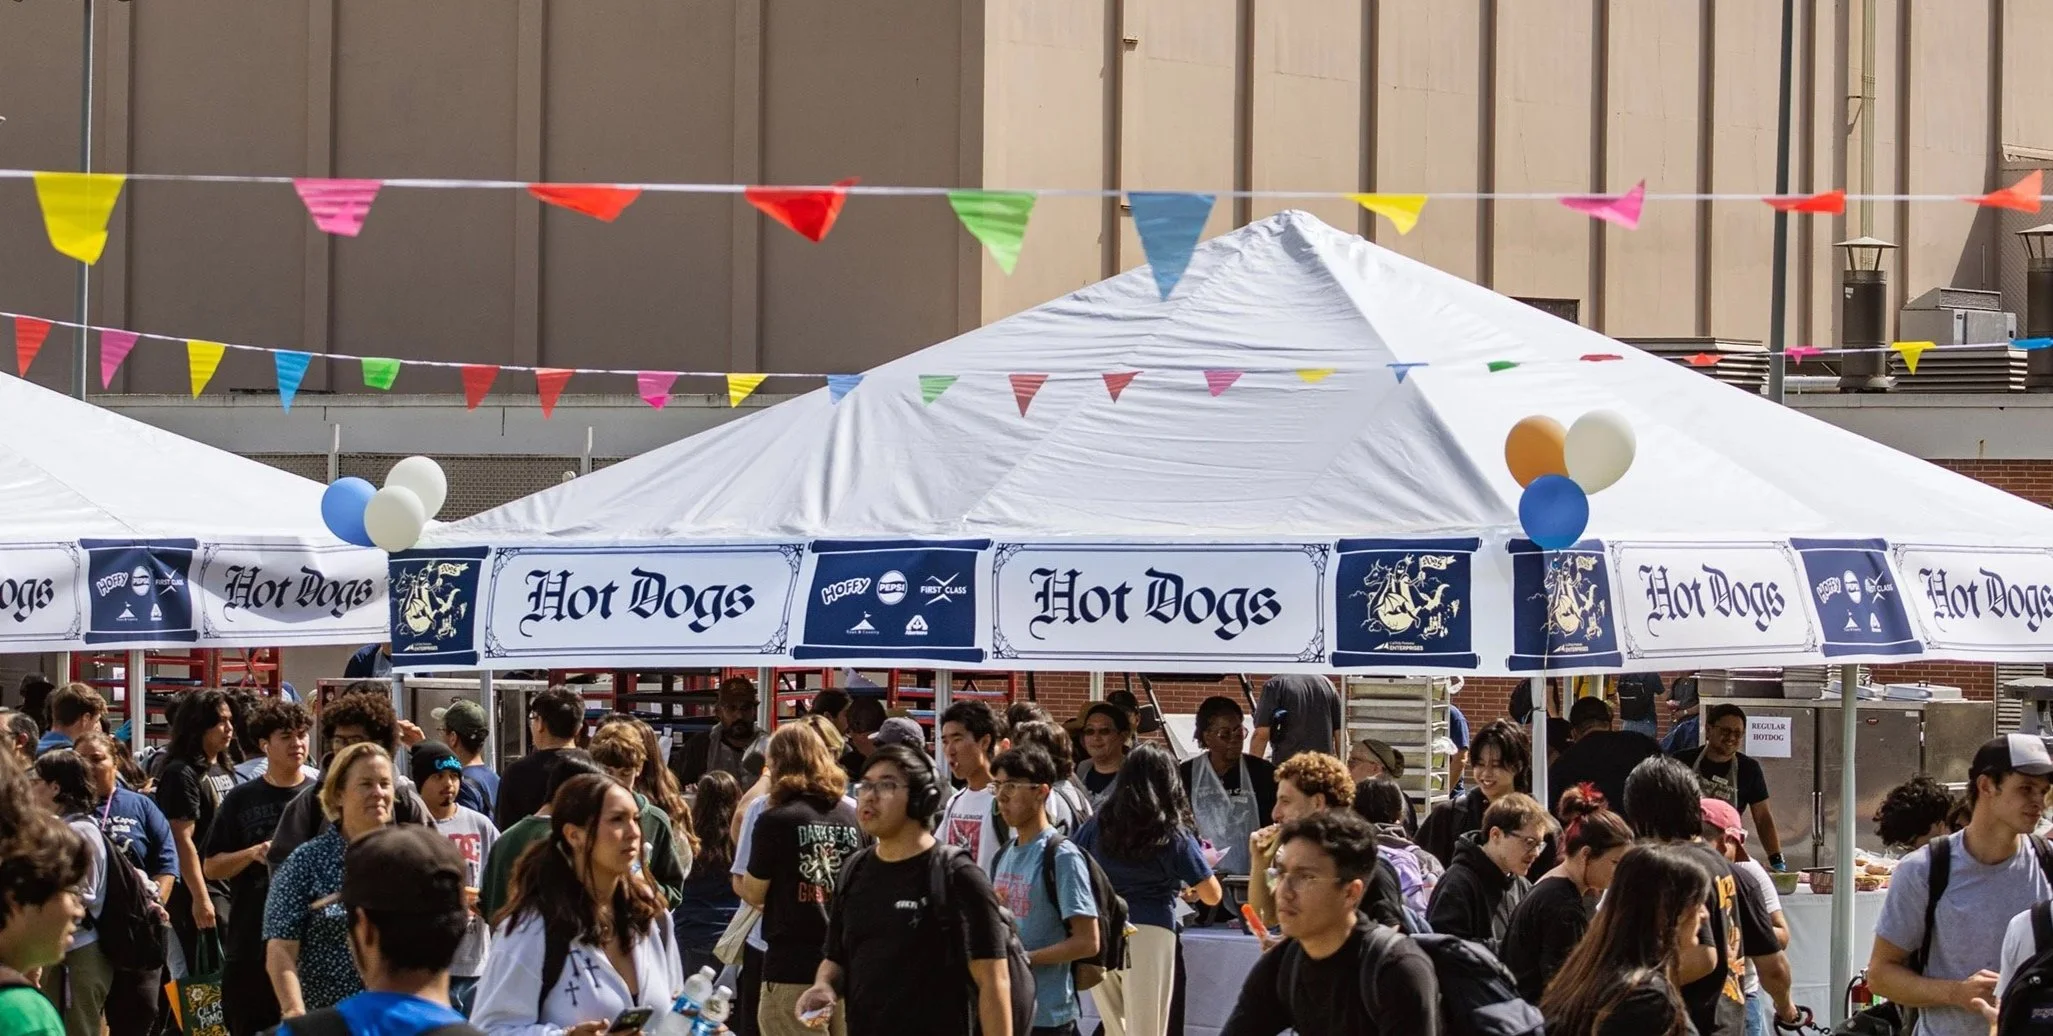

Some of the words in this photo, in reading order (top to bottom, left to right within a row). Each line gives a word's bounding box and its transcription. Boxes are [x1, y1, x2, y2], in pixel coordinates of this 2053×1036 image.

[0, 579, 54, 622] ogs
[96, 572, 128, 597] HOFFY
[223, 565, 293, 622] Hot
[294, 565, 373, 618] Dogs
[519, 569, 620, 637] Hot
[627, 566, 756, 634] Dogs
[821, 577, 871, 605] HOFFY
[879, 583, 905, 592] PEPSI
[920, 586, 942, 594] FIRST
[944, 586, 967, 594] CLASS
[1028, 568, 1133, 640] Hot
[1145, 567, 1282, 640] Dogs
[1638, 564, 1706, 638] Hot
[1701, 563, 1785, 632] Dogs
[1816, 577, 1841, 604] HOFFY
[1918, 567, 1980, 633] Hot
[1979, 567, 2053, 632] Dogs
